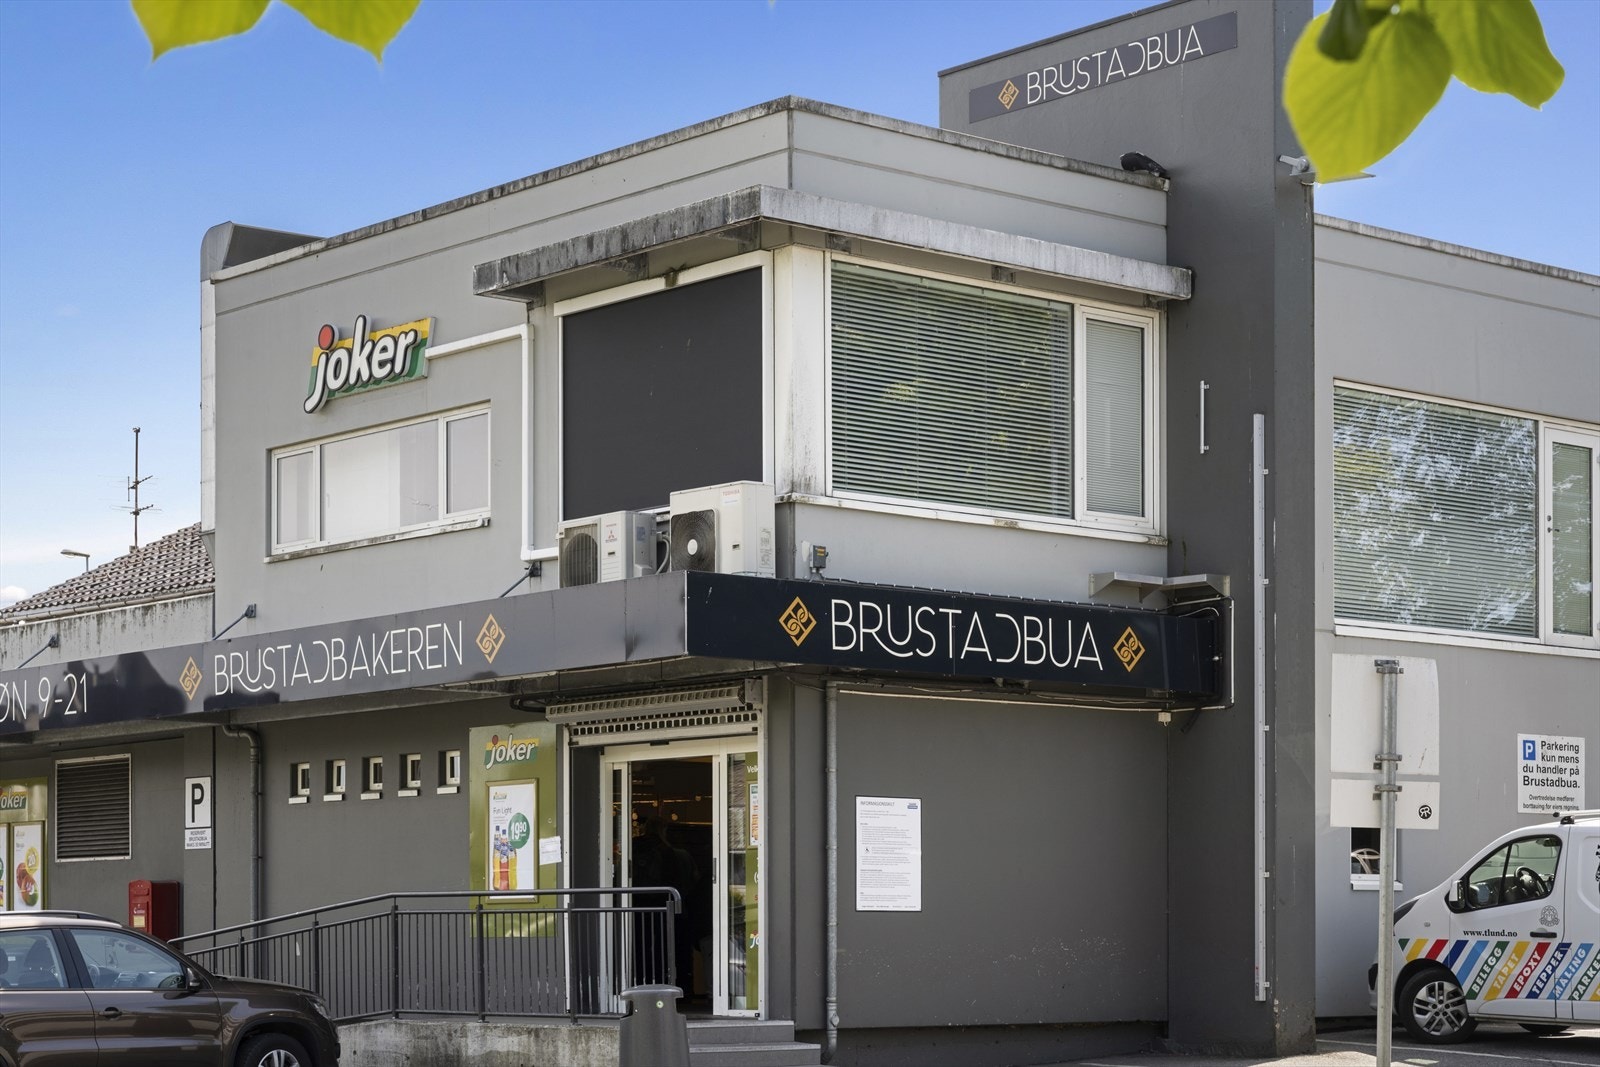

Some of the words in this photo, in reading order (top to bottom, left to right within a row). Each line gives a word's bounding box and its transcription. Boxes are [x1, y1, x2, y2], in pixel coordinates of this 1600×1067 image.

[1026, 24, 1204, 105] BRUSTADBUA
[303, 314, 418, 414] joker
[830, 598, 1104, 671] BRUSTADBUA
[214, 620, 463, 696] BRUSTADBAKEREN
[38, 672, 87, 718] 9-21
[486, 733, 536, 770] joker
[1525, 742, 1534, 758] P
[1540, 740, 1580, 754] Parkering
[1541, 752, 1556, 762] kun
[1557, 755, 1580, 764] mens
[1522, 764, 1534, 773] du
[1536, 764, 1568, 775] handler
[1569, 766, 1580, 777] på
[1523, 775, 1580, 788] Brustadbua.
[191, 783, 205, 823] P
[1463, 929, 1518, 937] www.tlund.no
[1471, 947, 1502, 993] BELEGG
[1493, 953, 1520, 990] TAPET
[1513, 950, 1542, 993] EPOXY
[1532, 949, 1564, 994] TEPPER
[1552, 948, 1586, 997] MALING
